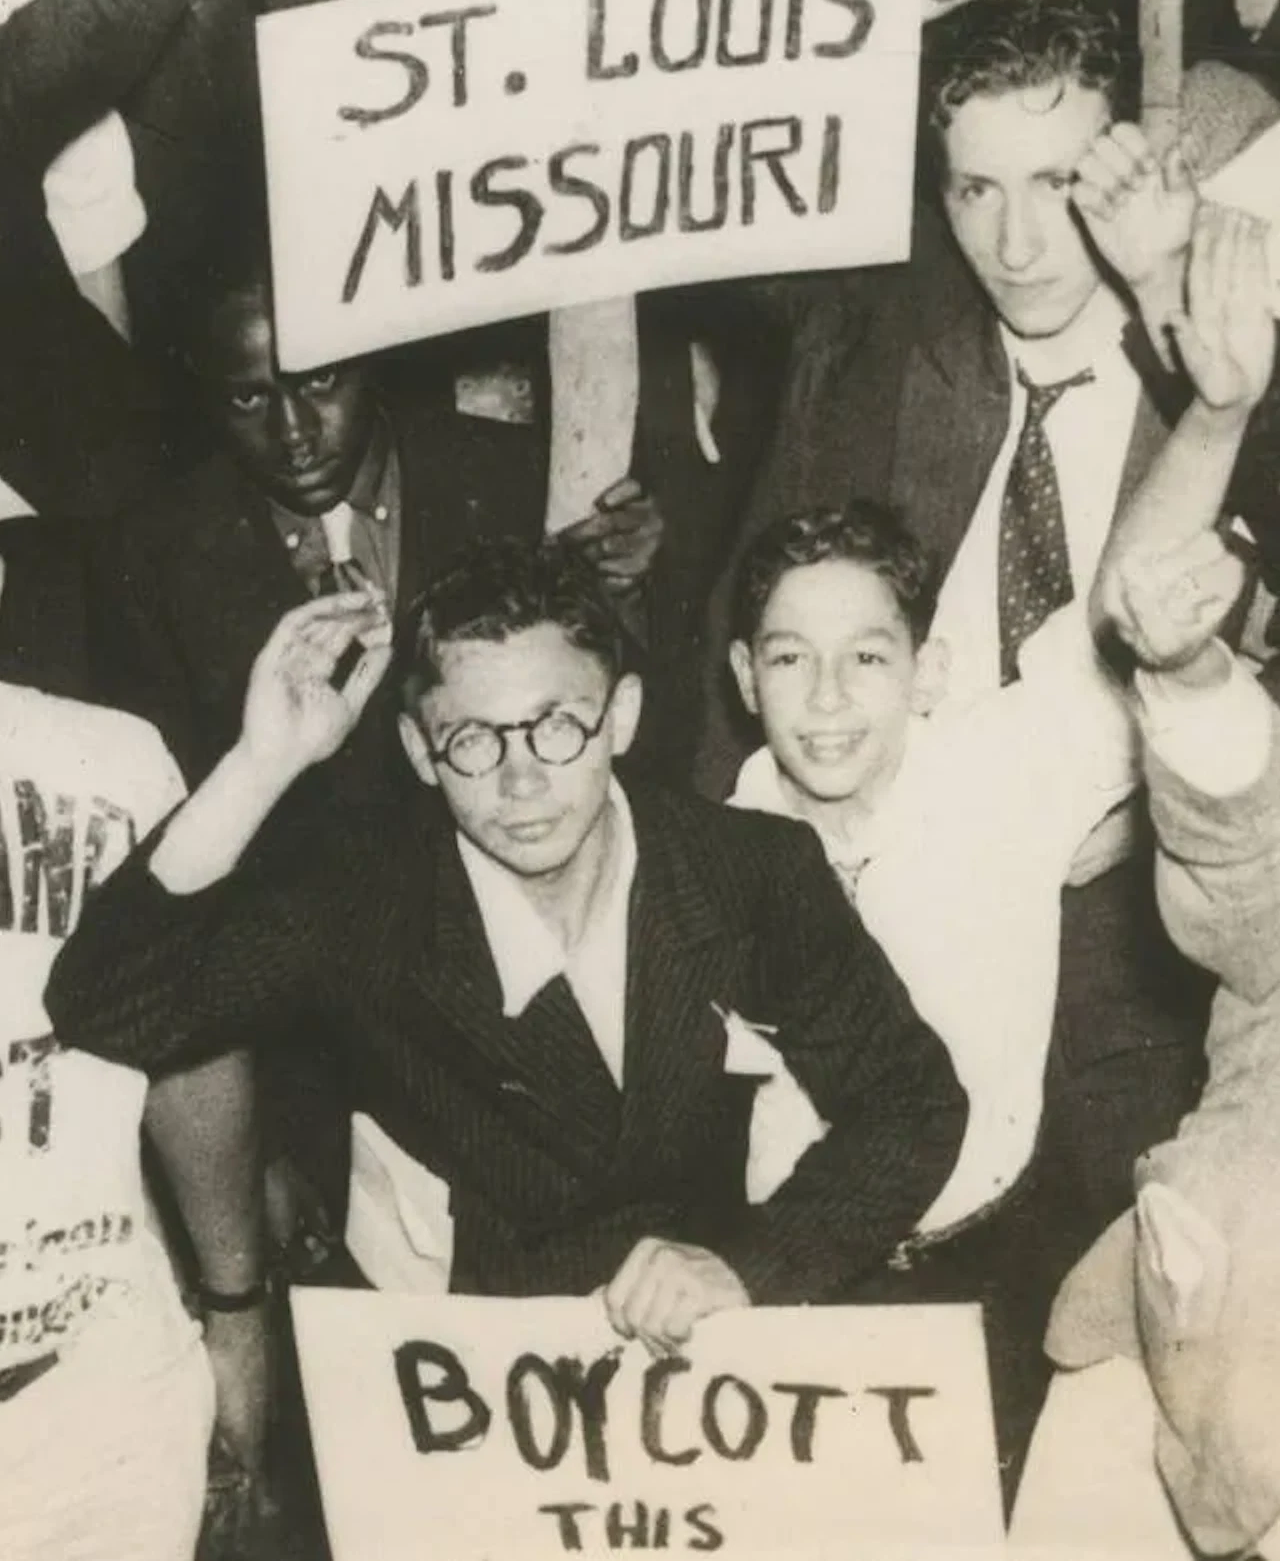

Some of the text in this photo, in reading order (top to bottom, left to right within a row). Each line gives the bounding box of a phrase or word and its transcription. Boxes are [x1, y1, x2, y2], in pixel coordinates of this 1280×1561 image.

[338, 3, 528, 127] ST.
[339, 113, 843, 305] MISSOURI
[392, 1338, 938, 1484] BOYCOTT
[538, 1500, 728, 1553] THIS
